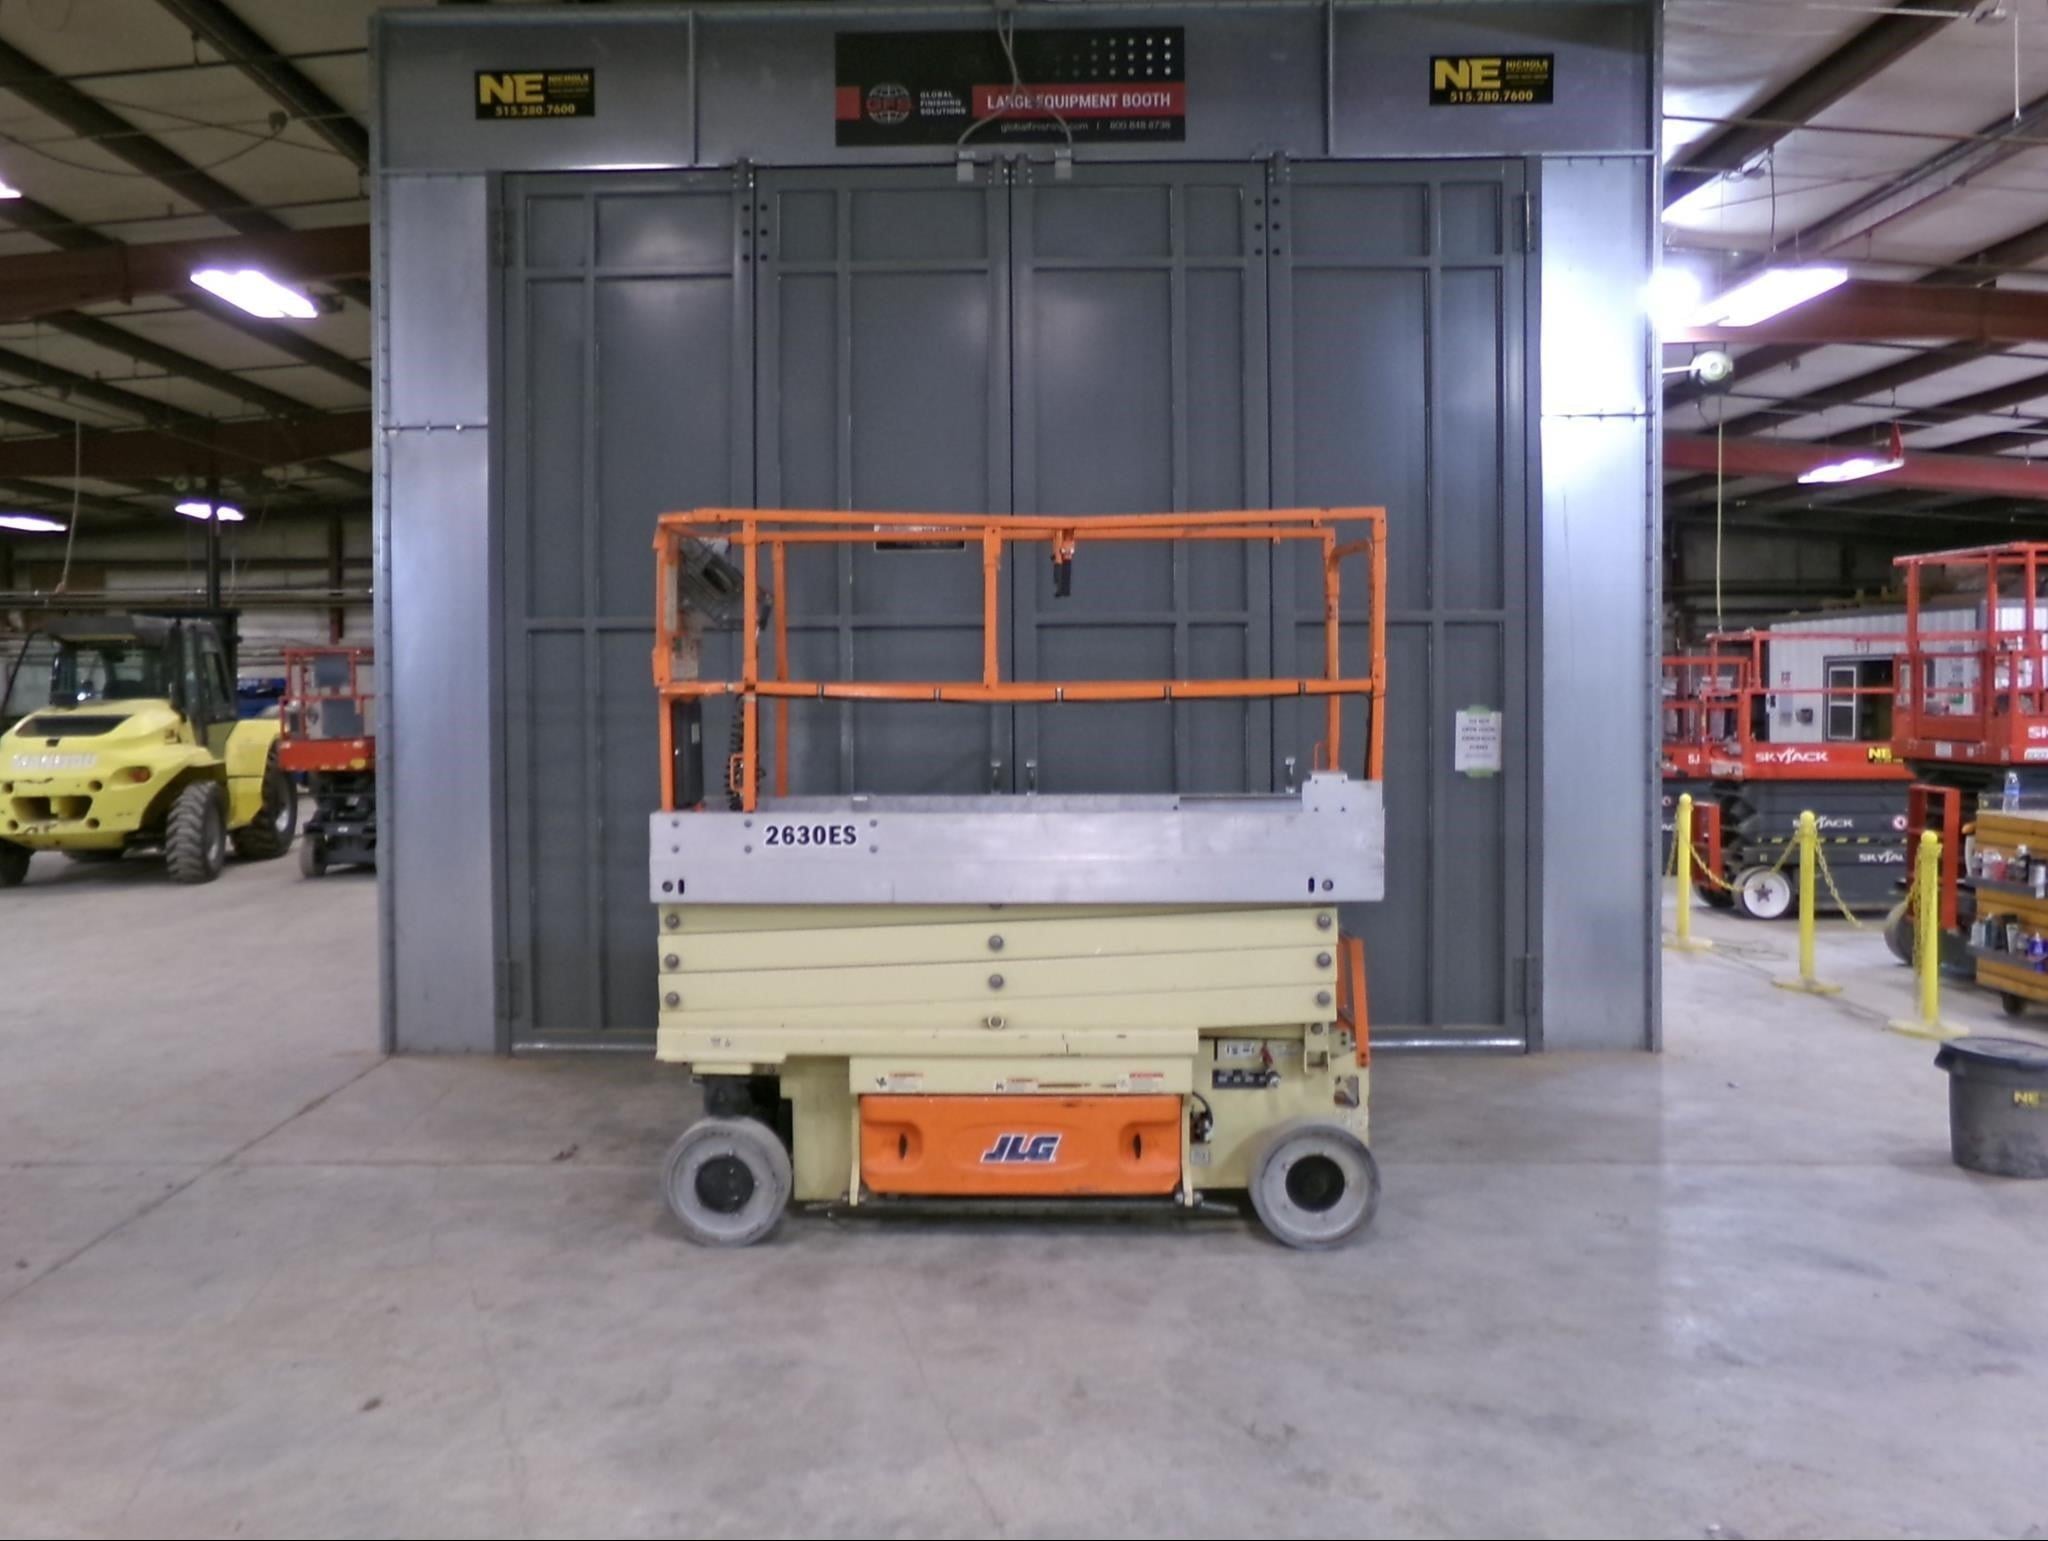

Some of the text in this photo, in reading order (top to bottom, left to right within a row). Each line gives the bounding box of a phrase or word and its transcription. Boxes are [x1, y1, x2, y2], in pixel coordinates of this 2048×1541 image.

[1434, 59, 1501, 90] NE
[480, 73, 544, 104] NE
[1450, 90, 1533, 103] 515.280.7600
[920, 99, 961, 107] FINISHING
[1122, 92, 1171, 108] BOOTH
[495, 104, 576, 117] 515.280.7600
[920, 107, 967, 115] SOLUTIONS
[1755, 748, 1829, 764] SKYJACK
[765, 825, 857, 846] 2630ES
[981, 1134, 1061, 1163] JLG
